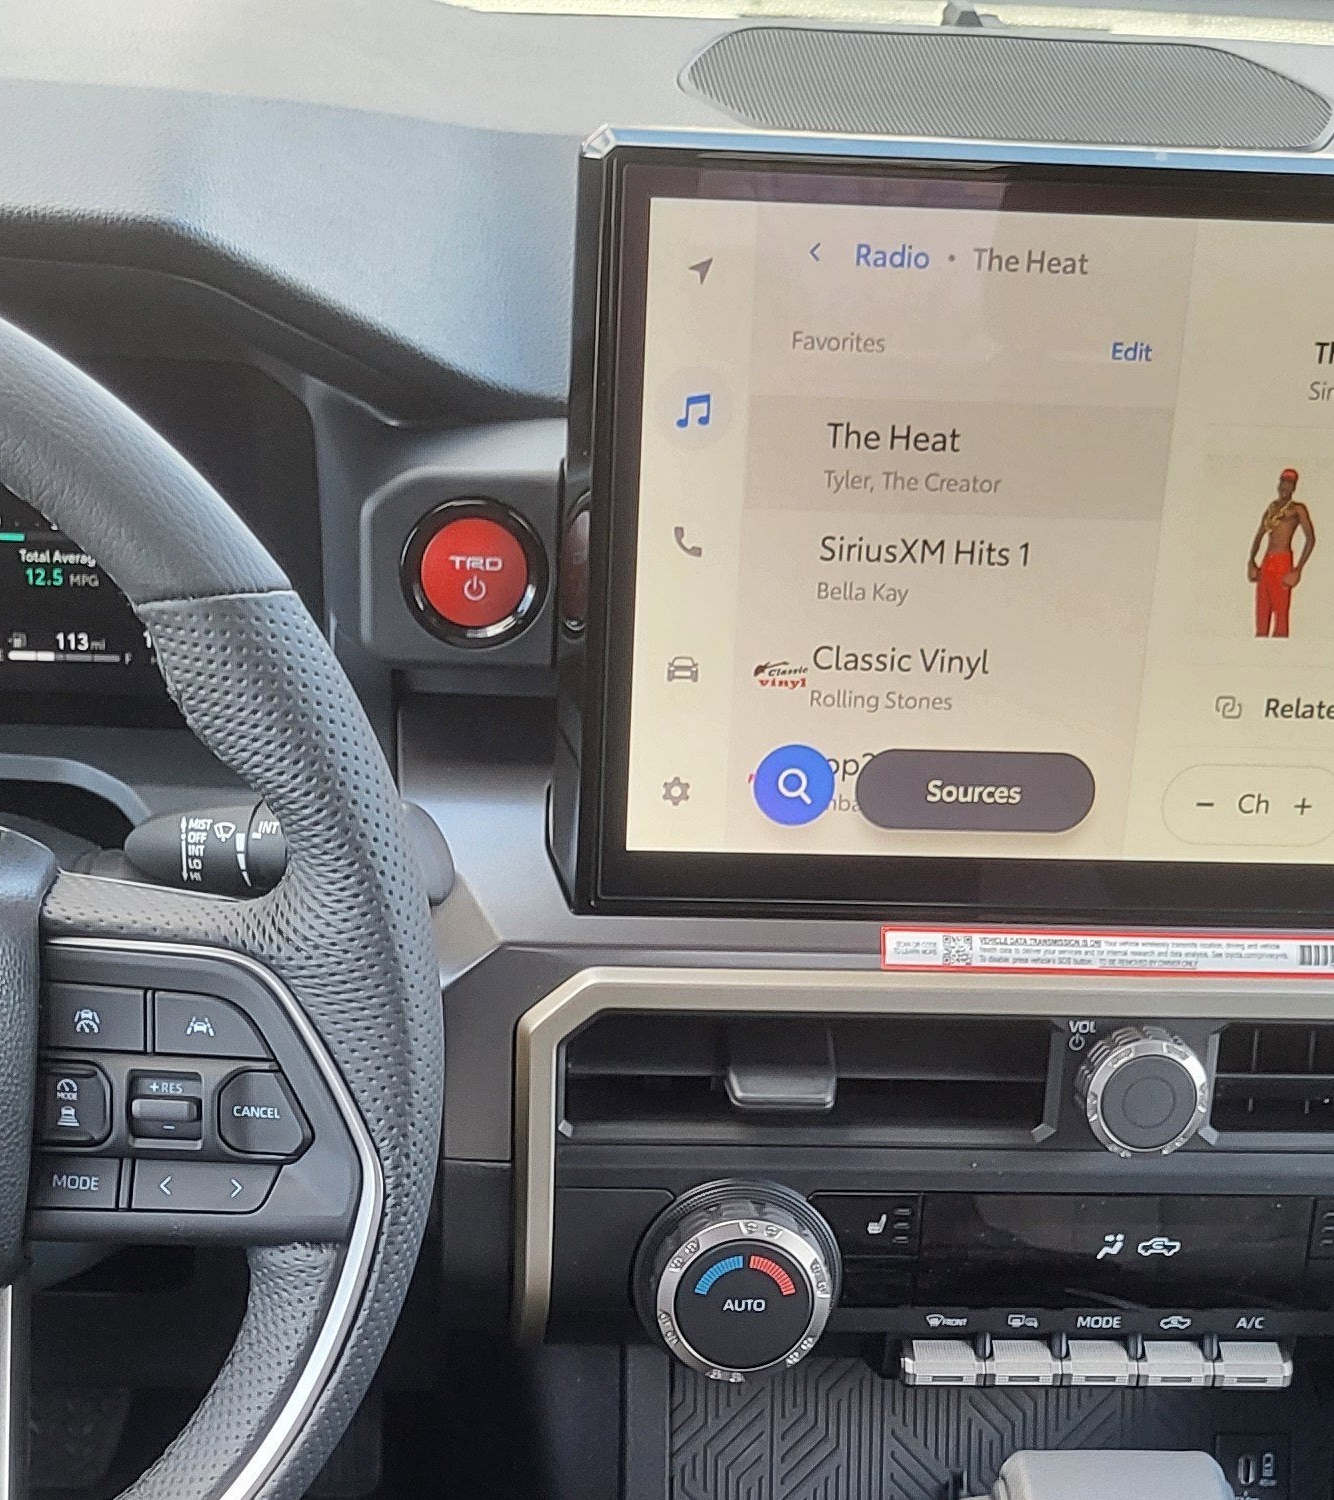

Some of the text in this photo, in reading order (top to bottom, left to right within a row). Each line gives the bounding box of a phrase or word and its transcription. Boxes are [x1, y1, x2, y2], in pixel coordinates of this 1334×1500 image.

[855, 243, 1090, 276] Radio The Heat
[791, 331, 886, 355] Favorites
[1111, 341, 1153, 363] Edit
[827, 421, 962, 453] The Heat
[824, 470, 1003, 495] Tyler, The Creator
[18, 549, 51, 564] Total
[819, 534, 1031, 568] SiriusXM Hits 1
[447, 555, 504, 572] TRD
[25, 567, 100, 588] 12.5 MPG
[816, 580, 909, 606] Bella Kay
[813, 645, 989, 680] Classic Vinyl
[809, 689, 953, 714] Rolling Stones
[926, 779, 1023, 806] Sources
[1237, 793, 1270, 815] Ch
[188, 817, 214, 831] MIST
[258, 821, 281, 835] INT
[187, 831, 208, 844] OFF
[1068, 1020, 1098, 1035] VOL
[233, 1105, 281, 1120] CANCEL
[51, 1173, 100, 1192] MODE
[722, 1298, 766, 1313] AUTO
[1076, 1315, 1123, 1330] MODE
[1235, 1315, 1267, 1330] A/C
